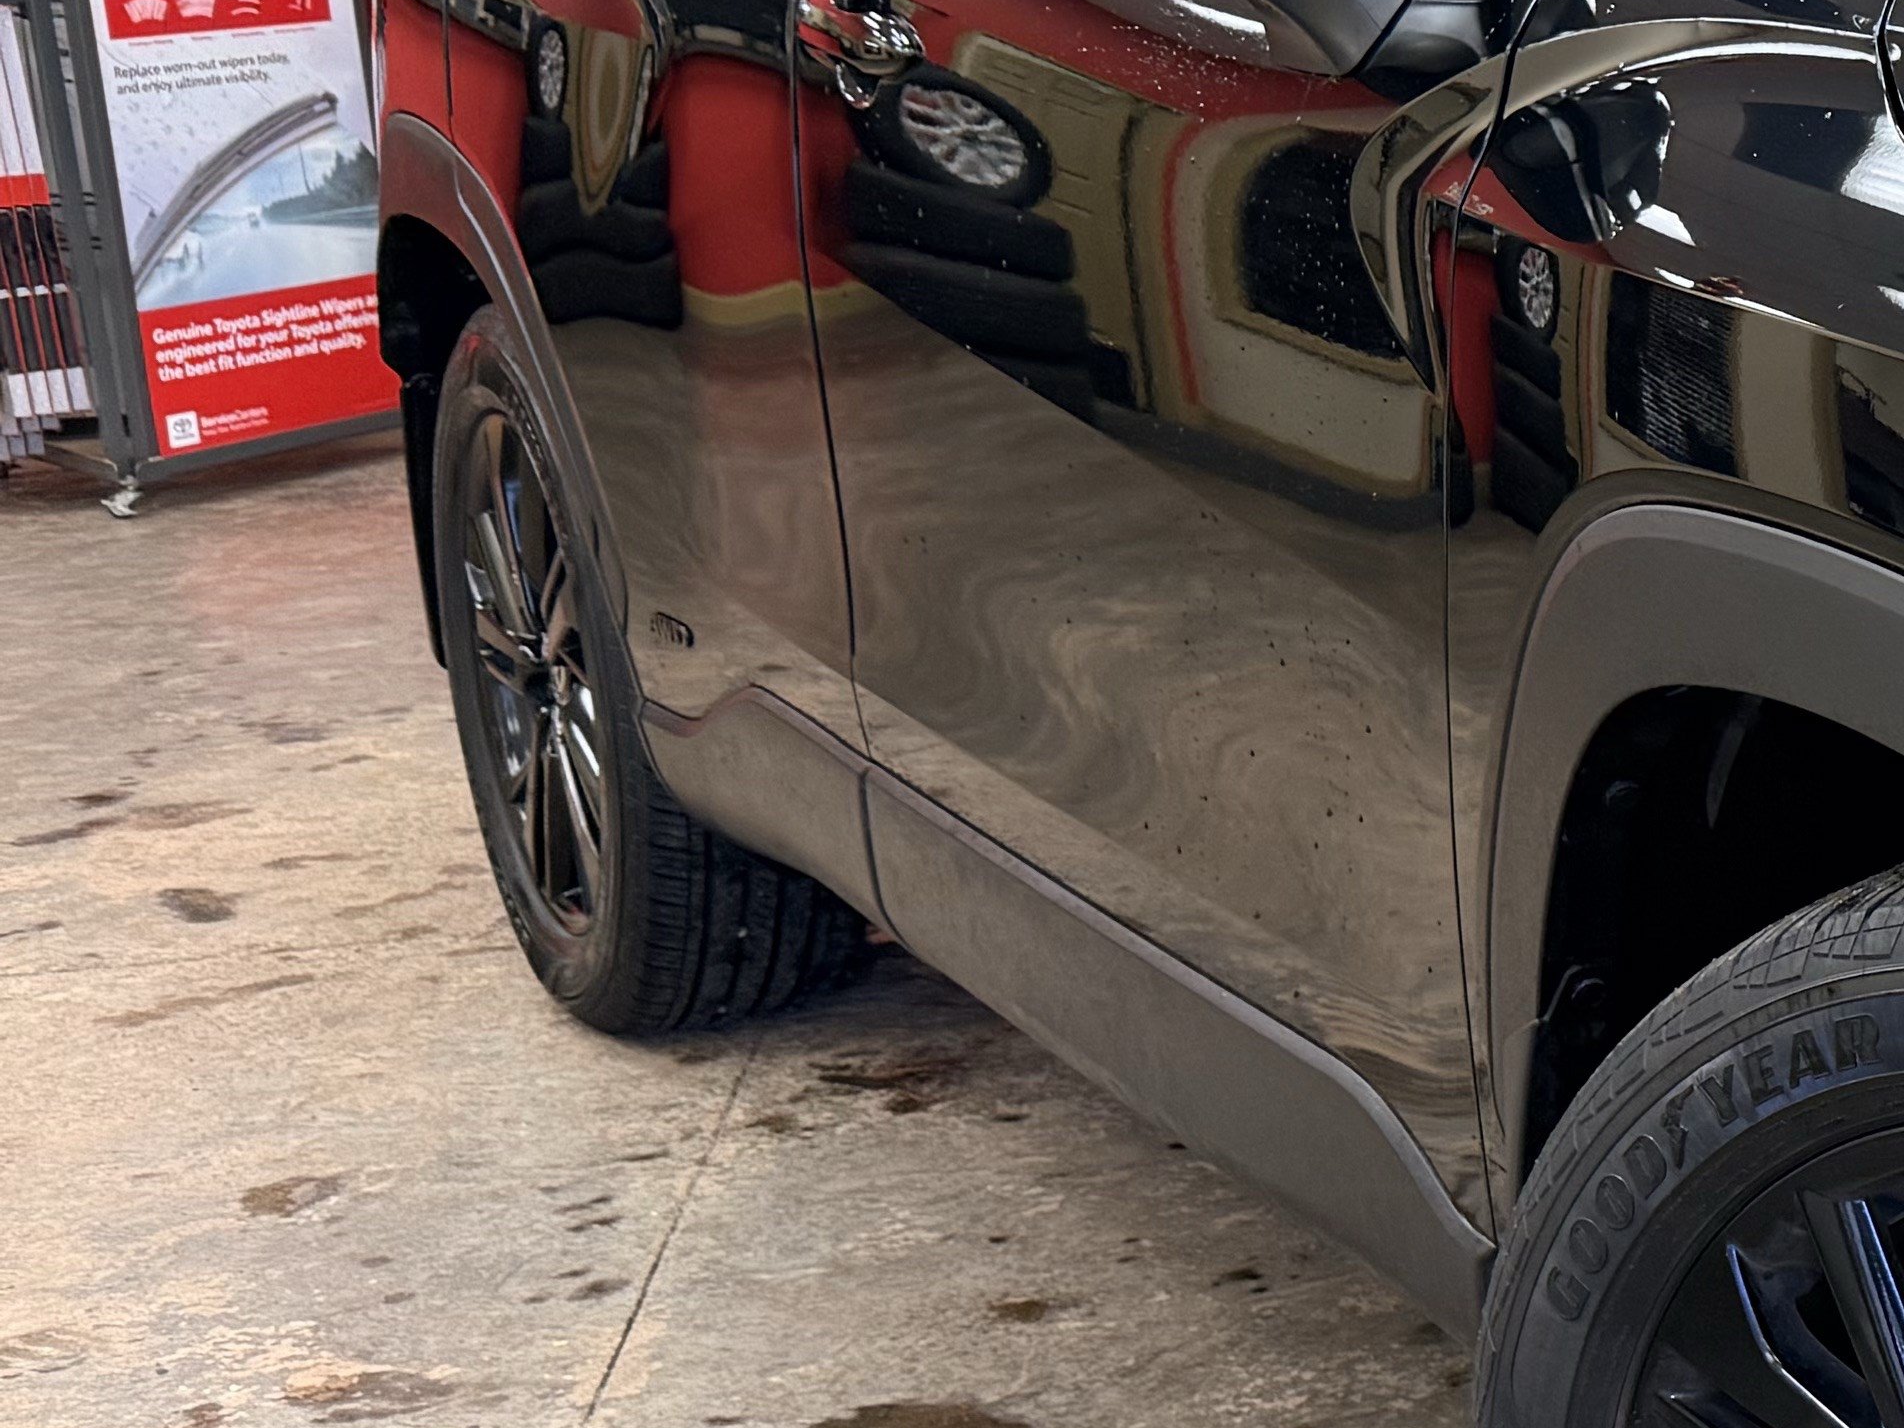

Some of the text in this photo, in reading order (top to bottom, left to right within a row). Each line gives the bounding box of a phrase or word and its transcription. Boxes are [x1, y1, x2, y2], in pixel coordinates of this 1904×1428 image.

[114, 65, 161, 80] Replace
[219, 55, 256, 69] wipers
[117, 83, 140, 94] and
[142, 80, 173, 93] enjoy
[175, 74, 223, 89] ultimate
[153, 321, 213, 344] Genuine
[213, 314, 261, 334] Toyota
[261, 304, 320, 327] Sightline
[319, 297, 365, 314] Wipers
[156, 333, 236, 364] engineered
[236, 332, 257, 348] for
[257, 329, 289, 348] your
[289, 320, 334, 340] Toyota
[159, 364, 184, 382] the
[184, 358, 217, 377] best
[217, 354, 236, 371] fit
[236, 345, 293, 368] function
[293, 338, 319, 357] and
[1546, 1014, 1881, 1321] GOODYEAR
